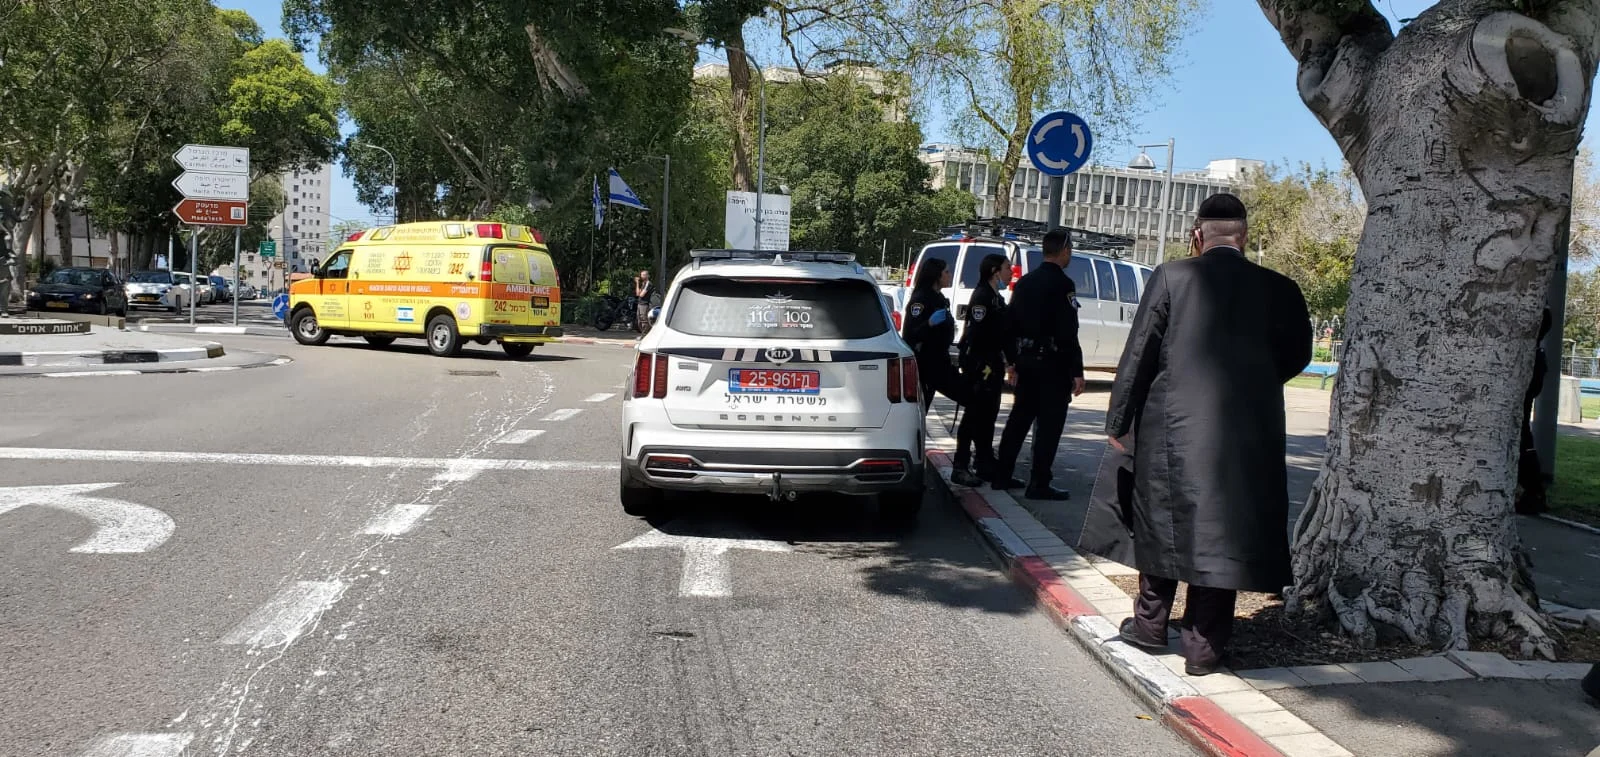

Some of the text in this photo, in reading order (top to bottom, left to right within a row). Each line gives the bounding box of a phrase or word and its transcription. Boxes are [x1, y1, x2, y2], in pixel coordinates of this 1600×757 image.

[505, 284, 551, 295] AMBULANCE
[494, 300, 507, 312] 242
[509, 303, 526, 312] כרמל
[363, 312, 374, 320] 101
[783, 310, 811, 323] 100
[771, 350, 787, 358] KIA
[724, 392, 827, 406] משטרת ישראל
[719, 413, 837, 422] SORENTO
